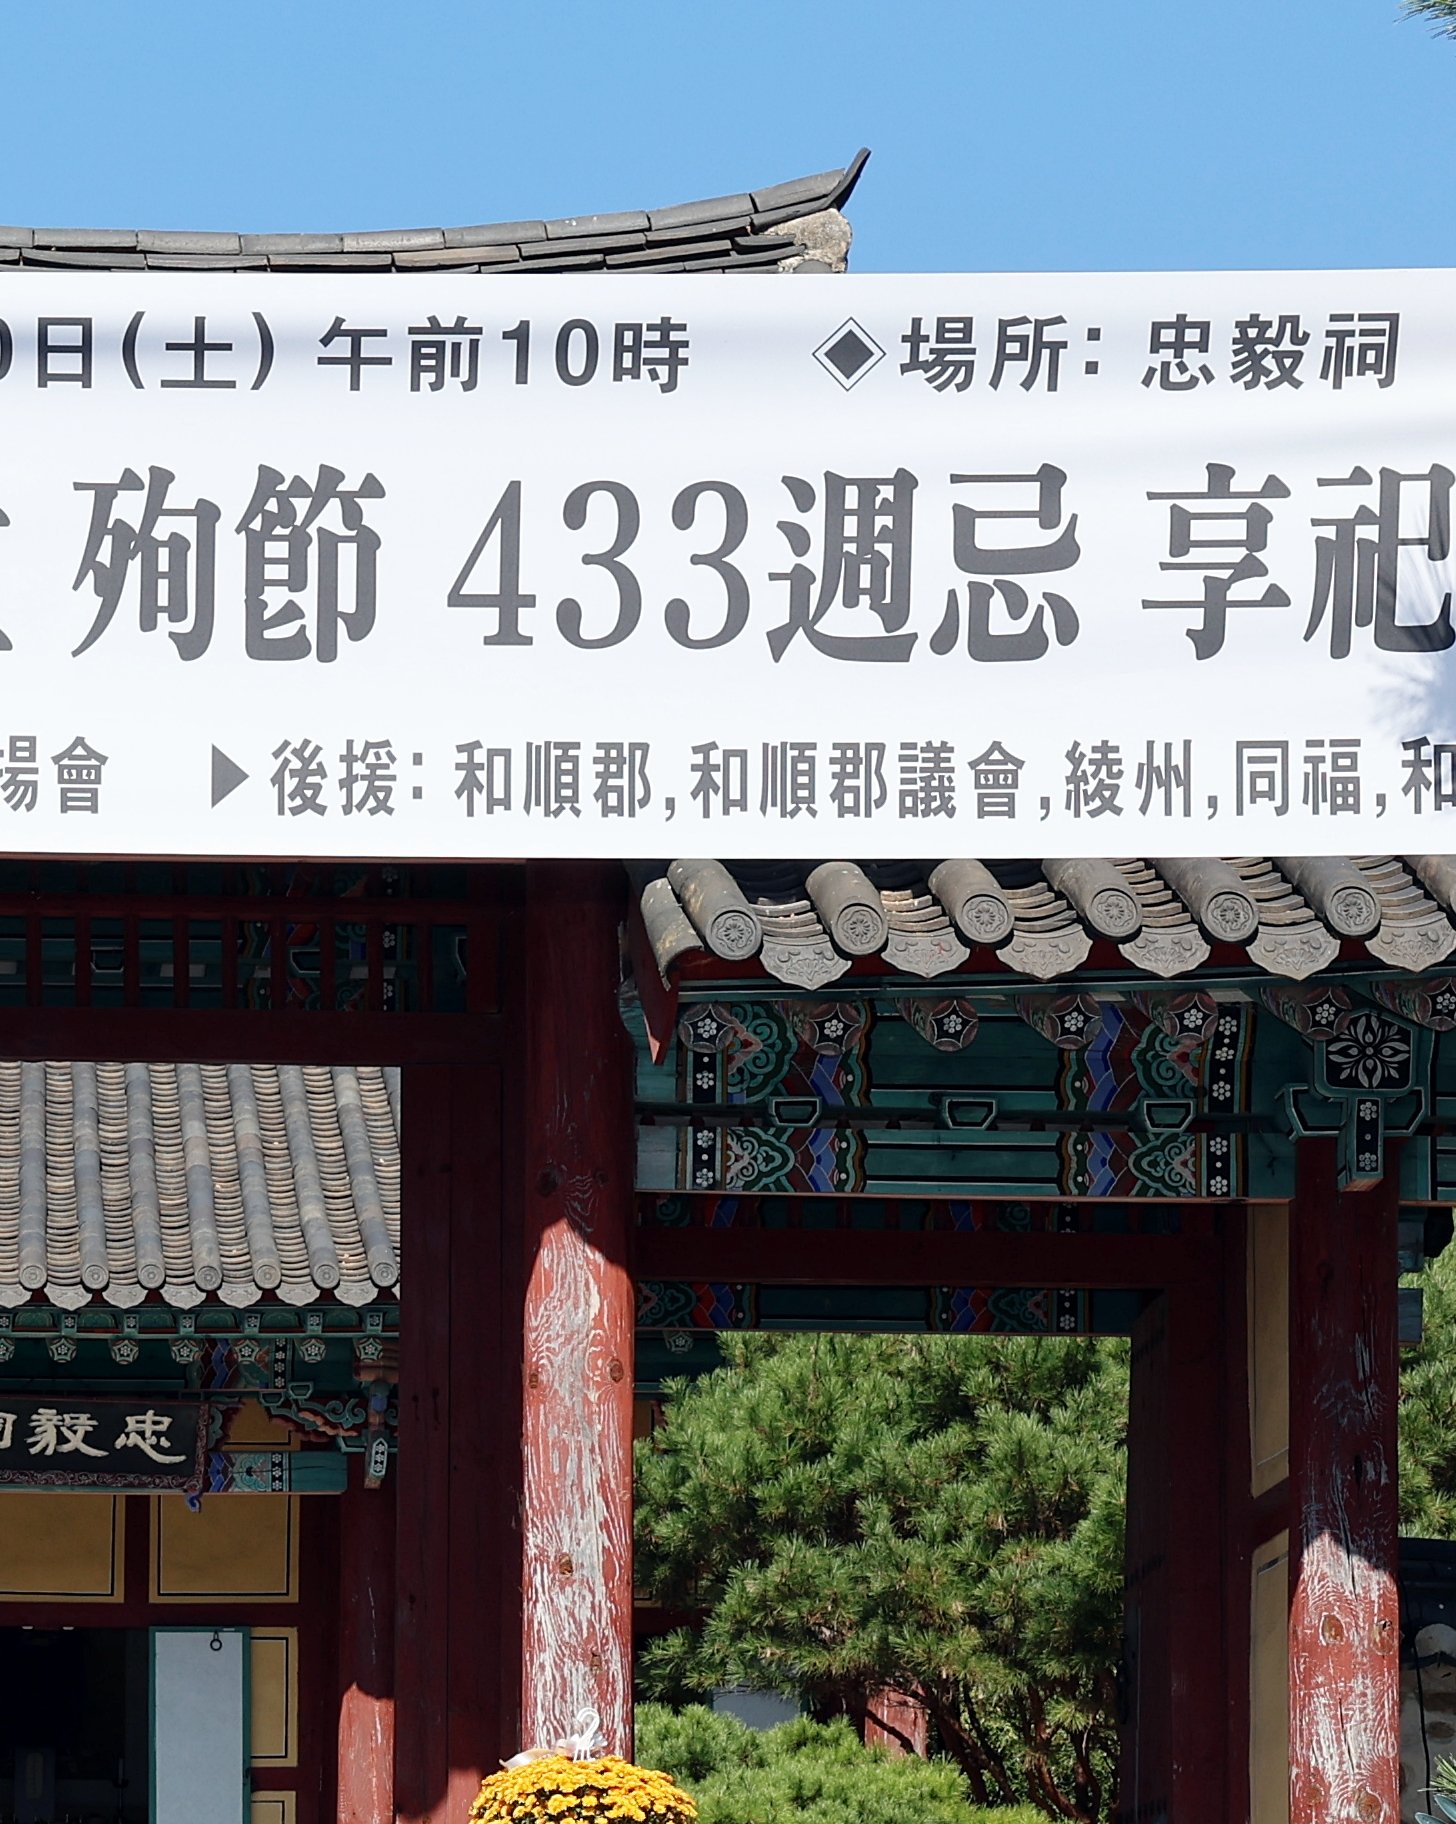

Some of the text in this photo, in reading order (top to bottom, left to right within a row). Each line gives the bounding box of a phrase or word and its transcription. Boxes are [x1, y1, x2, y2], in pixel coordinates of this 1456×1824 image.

[317, 315, 689, 393] 午前10時
[900, 313, 1400, 392] 場所: 忠毅祠
[72, 464, 386, 663] 殉節
[447, 463, 1080, 663] 433週忌
[270, 739, 422, 816] 後援:
